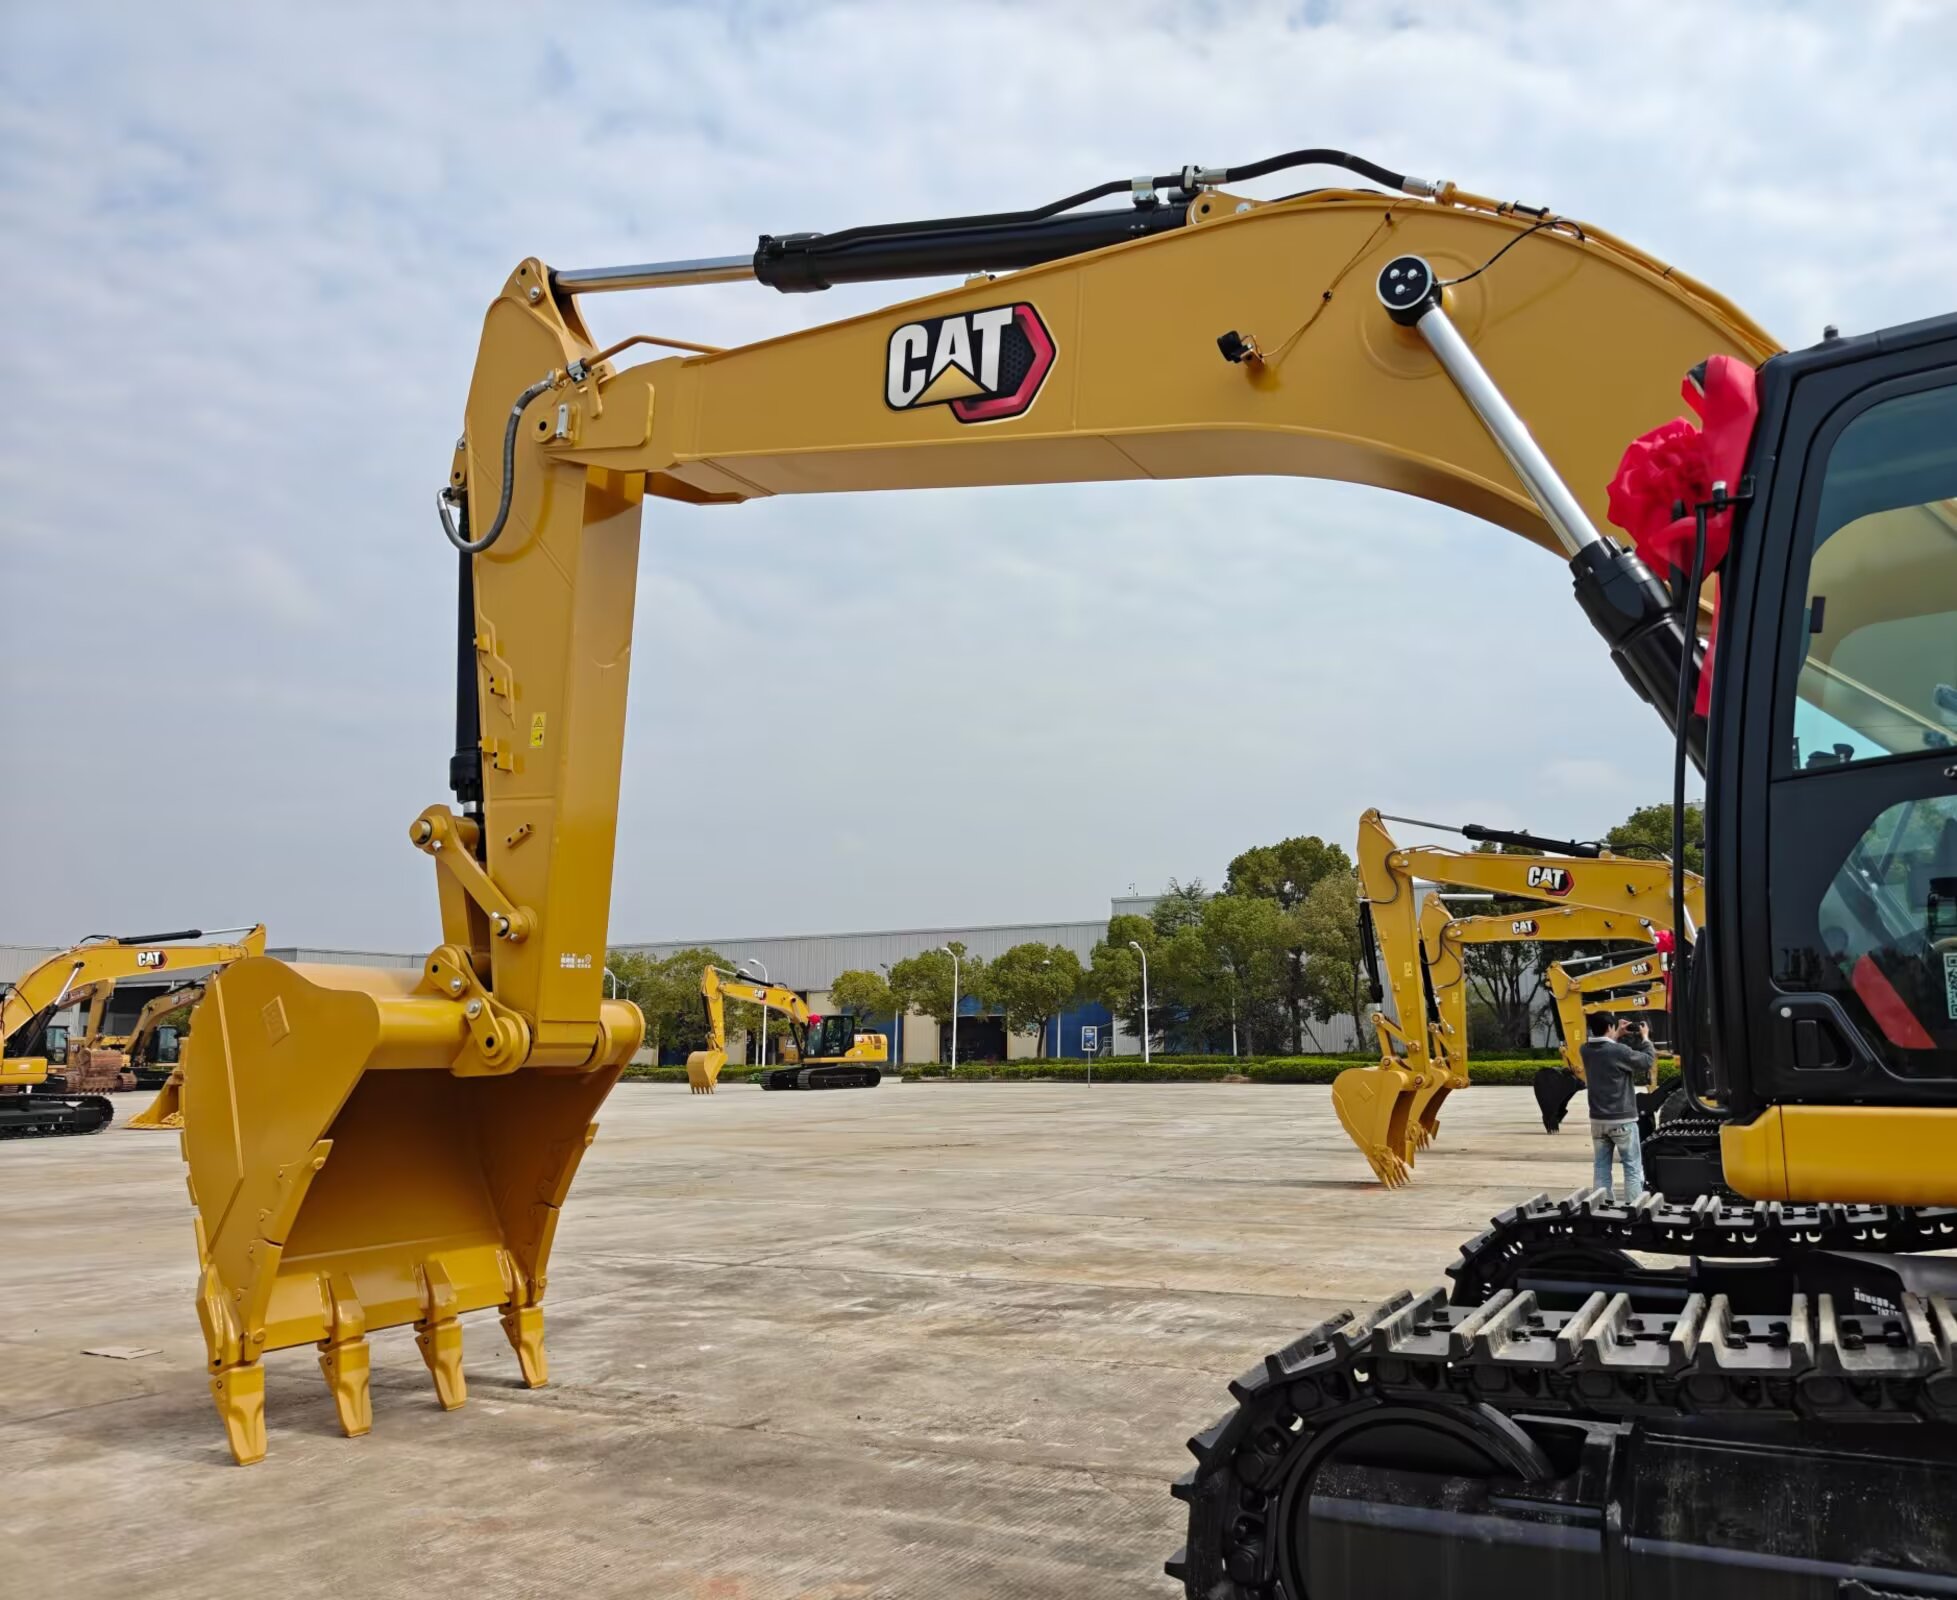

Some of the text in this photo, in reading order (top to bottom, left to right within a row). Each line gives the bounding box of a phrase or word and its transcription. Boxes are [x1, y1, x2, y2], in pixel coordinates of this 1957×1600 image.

[888, 307, 1013, 408] CAT
[1528, 866, 1564, 890] CAT
[1512, 920, 1533, 934] CAT
[138, 951, 160, 967] CAT
[1631, 962, 1648, 975] CAT
[1633, 996, 1646, 1006] CAT
